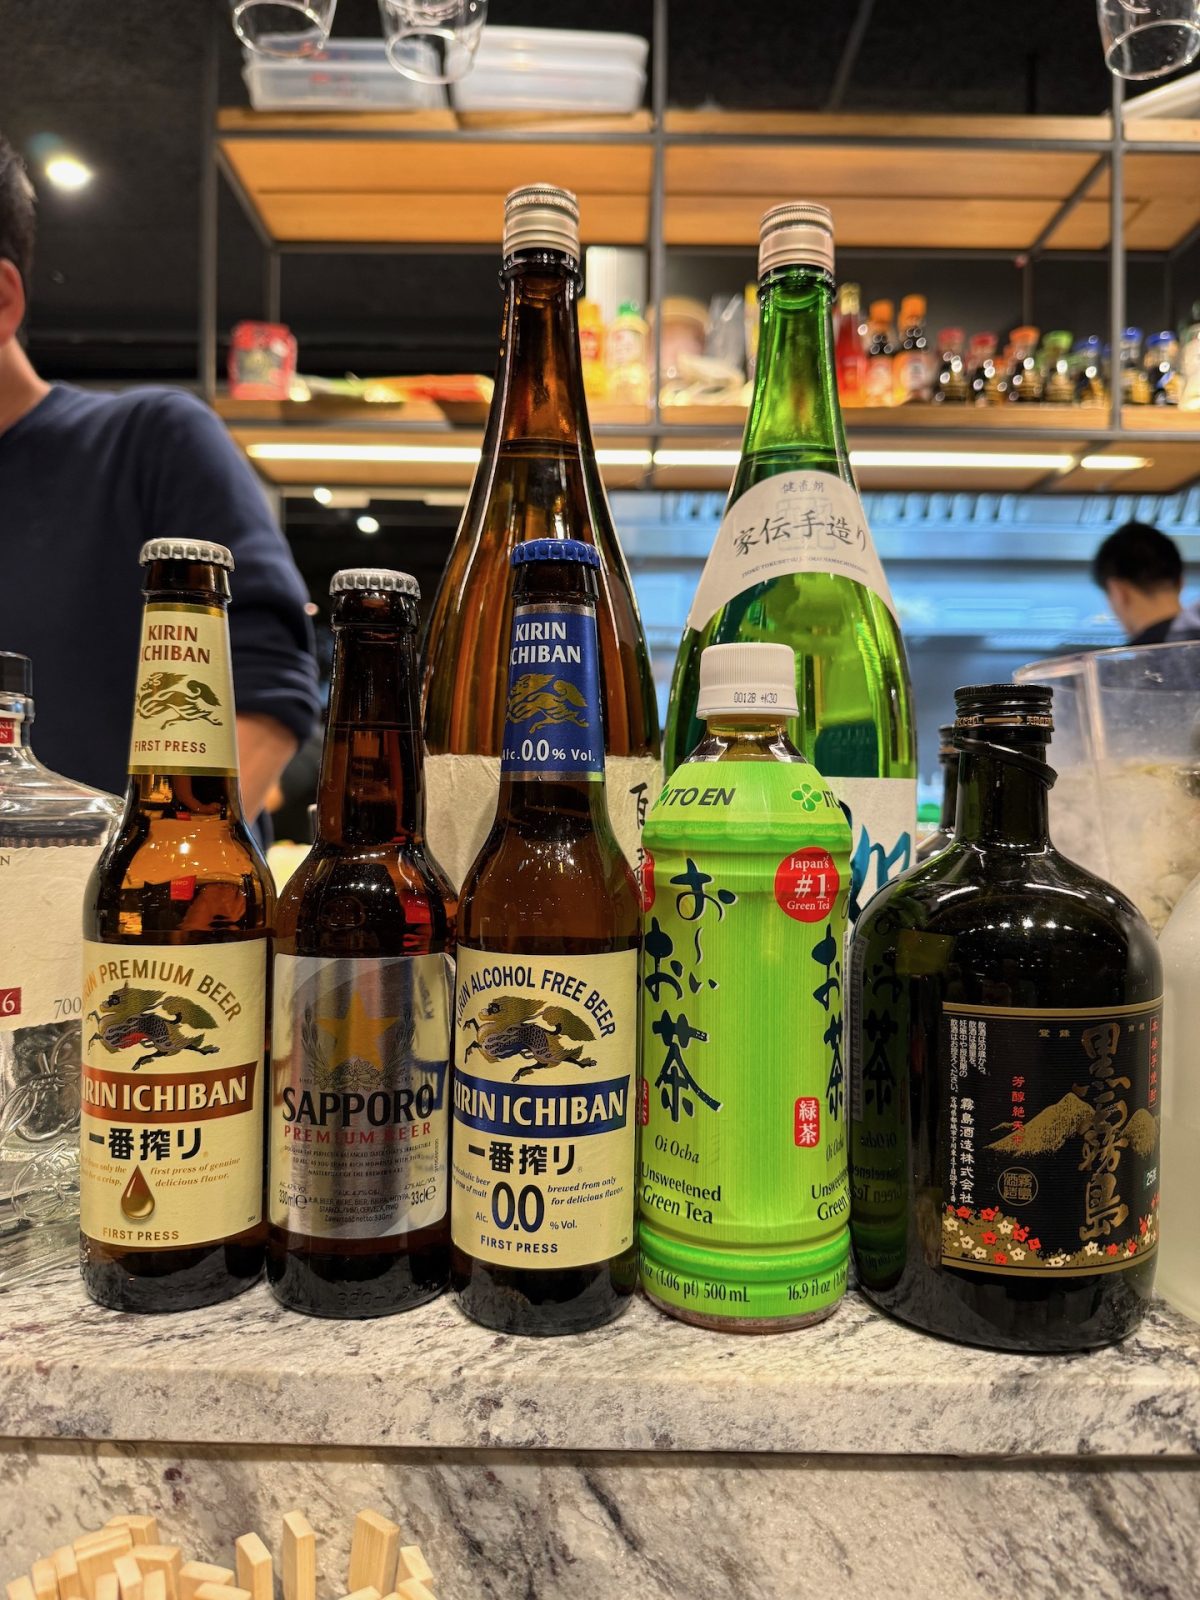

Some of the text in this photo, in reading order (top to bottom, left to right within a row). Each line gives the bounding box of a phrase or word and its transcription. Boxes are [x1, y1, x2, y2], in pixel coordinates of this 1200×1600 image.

[733, 509, 866, 557] 家伝手造り
[148, 624, 198, 643] KIRIN
[515, 621, 567, 642] KIRIN
[134, 739, 207, 754] FIRST PRESS
[521, 739, 550, 762] 0.0
[552, 748, 566, 761] %
[571, 749, 596, 762] Vol.
[663, 787, 737, 806] ITO EN
[789, 856, 829, 871] Japan's
[794, 873, 828, 900] #1
[787, 900, 831, 911] Green Tea
[99, 959, 195, 987] PREMIUM
[197, 974, 242, 1022] BEER
[470, 966, 536, 995] ALCOHOL
[540, 969, 588, 1002] FREE
[583, 990, 616, 1038] BEER
[123, 1075, 247, 1112] ICHIBAN
[282, 1083, 434, 1127] SAPPORO
[502, 1088, 624, 1127] ICHIBAN
[284, 1121, 431, 1145] PREMIUM BEER
[798, 1099, 818, 1145] 緑茶
[89, 1127, 202, 1161] 一番搾り
[655, 1134, 700, 1164] Oi Ocha
[960, 1097, 975, 1204] 霧島酒造株式会社
[150, 1167, 170, 1175] first
[172, 1166, 197, 1175] press
[468, 1140, 575, 1176] 一番搾り
[155, 1173, 229, 1187] delicious flavor.
[476, 1175, 490, 1186] beer
[547, 1183, 579, 1193] brewed
[581, 1181, 600, 1190] from
[641, 1161, 721, 1202] Unsweetened
[475, 1181, 577, 1233] Alc. 0.0 % Vol.
[551, 1197, 565, 1205] for
[566, 1192, 603, 1204] delicious
[643, 1184, 713, 1224] Green Tea
[817, 1197, 847, 1222] Green
[103, 1226, 180, 1241] FIRST PRESS
[480, 1234, 558, 1254] FIRST PRESS
[656, 1267, 680, 1291] (1.06
[683, 1279, 699, 1300] pt)
[704, 1282, 726, 1301] 500
[729, 1285, 750, 1303] mL
[787, 1283, 808, 1300] 16.9
[821, 1281, 830, 1295] oz
